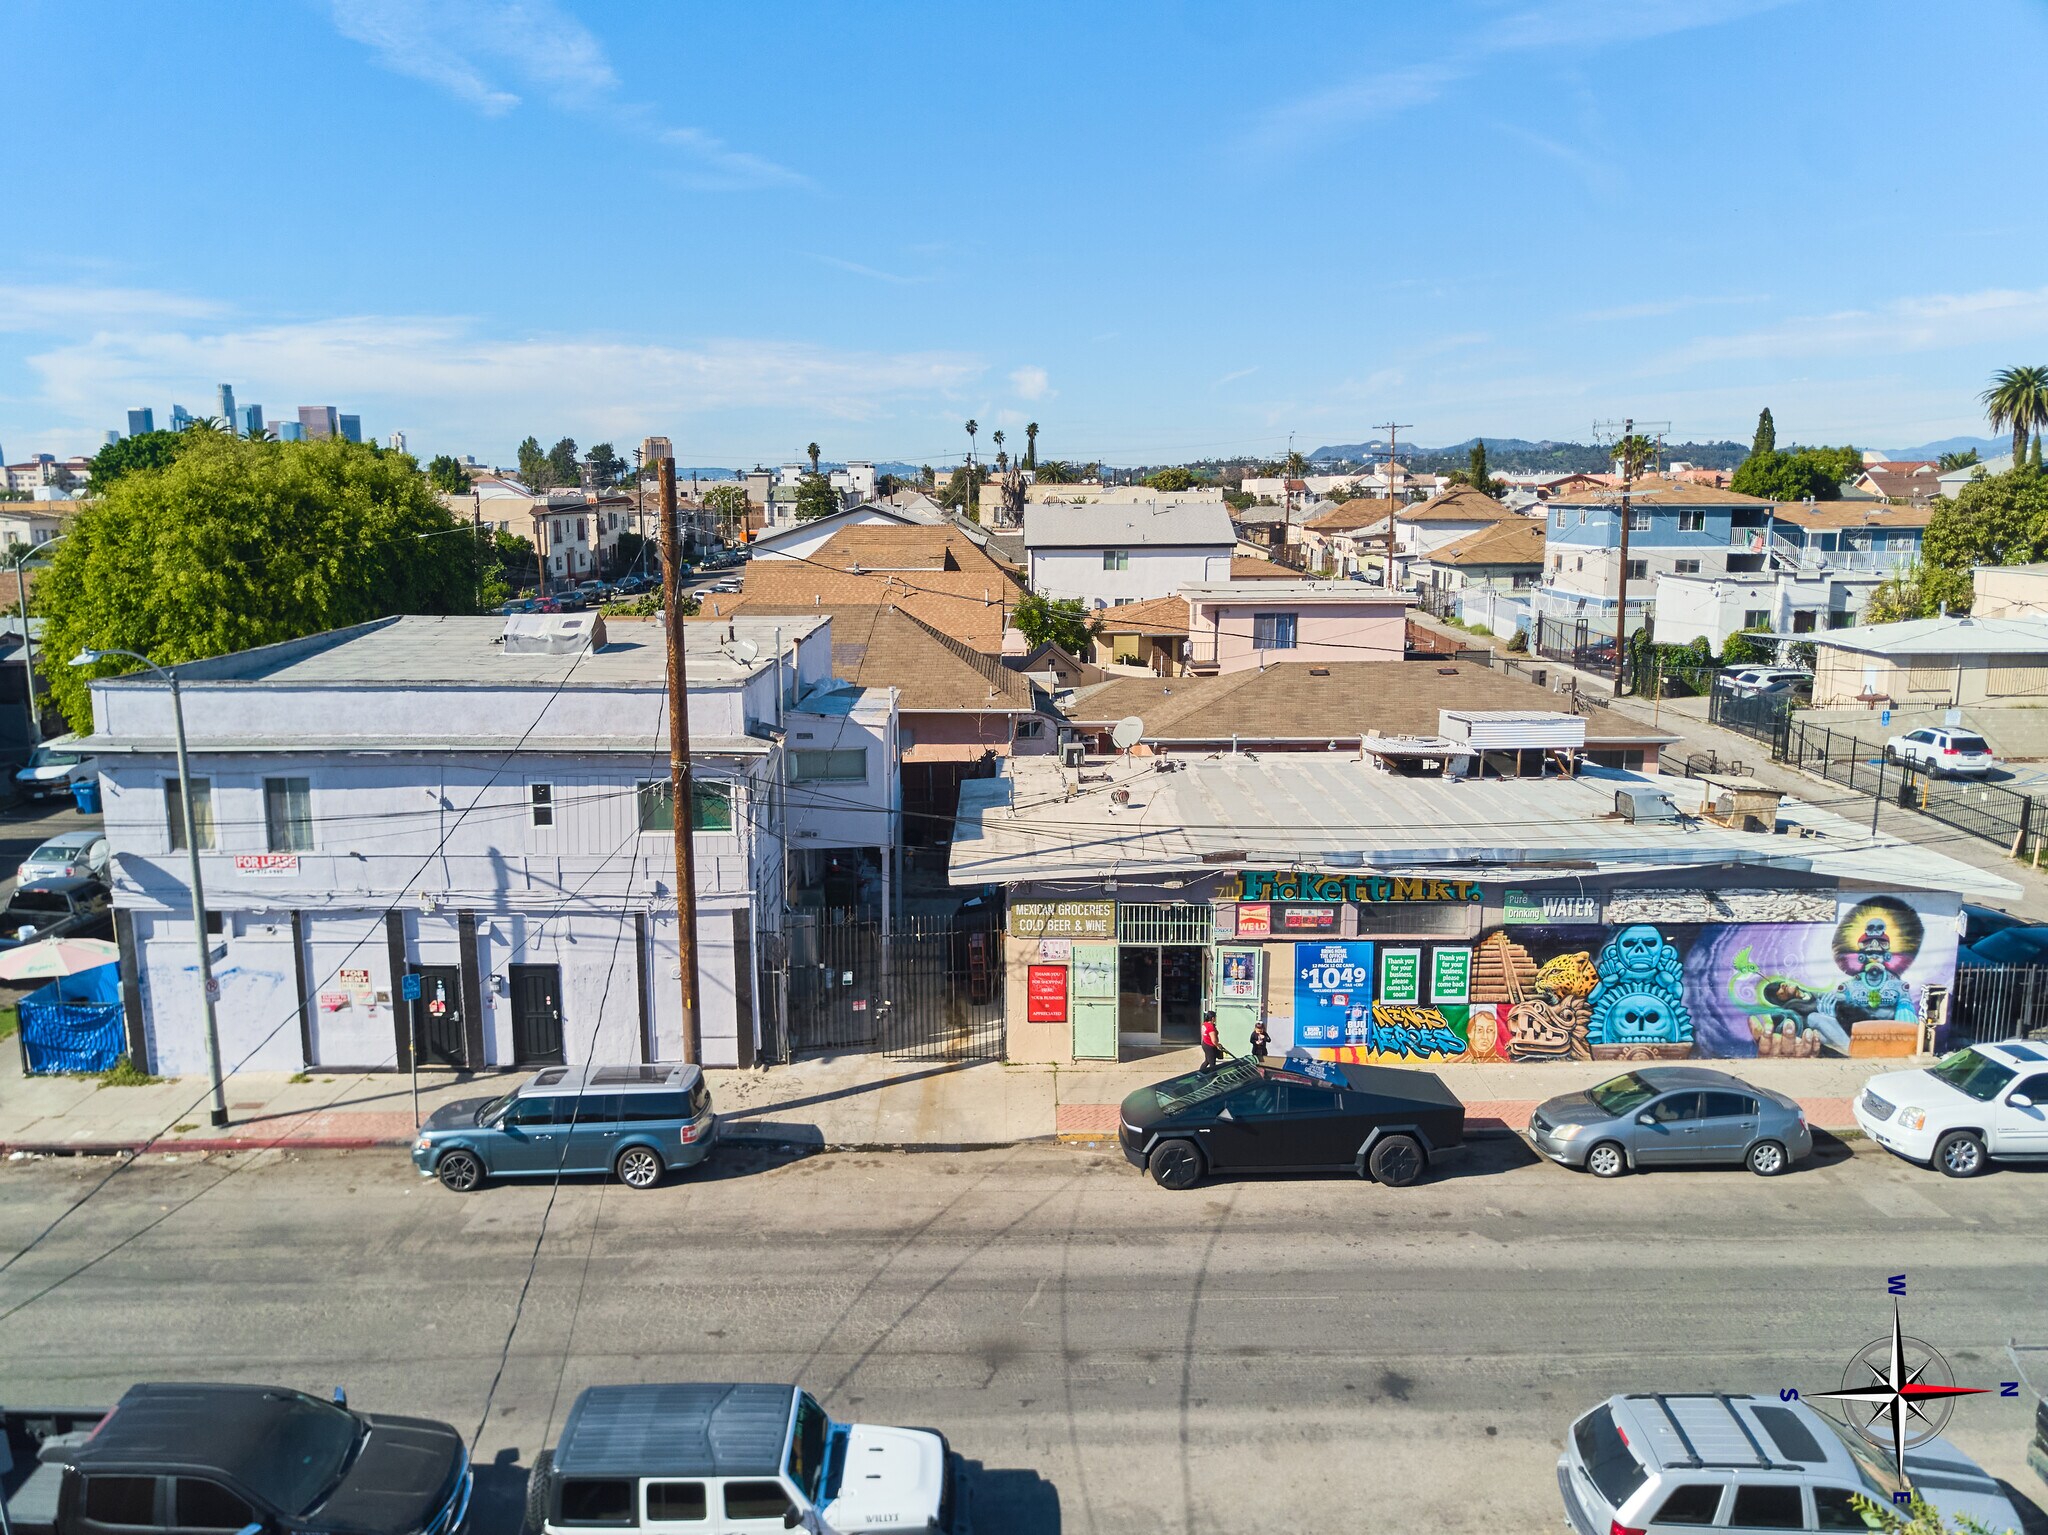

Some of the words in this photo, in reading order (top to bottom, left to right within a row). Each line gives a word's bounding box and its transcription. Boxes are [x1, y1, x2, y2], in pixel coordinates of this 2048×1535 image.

[237, 856, 259, 867] FOR
[261, 856, 296, 868] LEASE
[1509, 894, 1528, 904] Pure
[1016, 904, 1055, 916] MEXICAN
[1058, 904, 1110, 916] GROCERIES
[1508, 908, 1540, 920] Drinking
[1542, 898, 1595, 917] WATER
[1020, 920, 1044, 931] COLD
[1048, 920, 1071, 931] BEER
[1075, 920, 1082, 931] &
[1085, 920, 1107, 932] WINE
[866, 1513, 899, 1522] WILLYS
